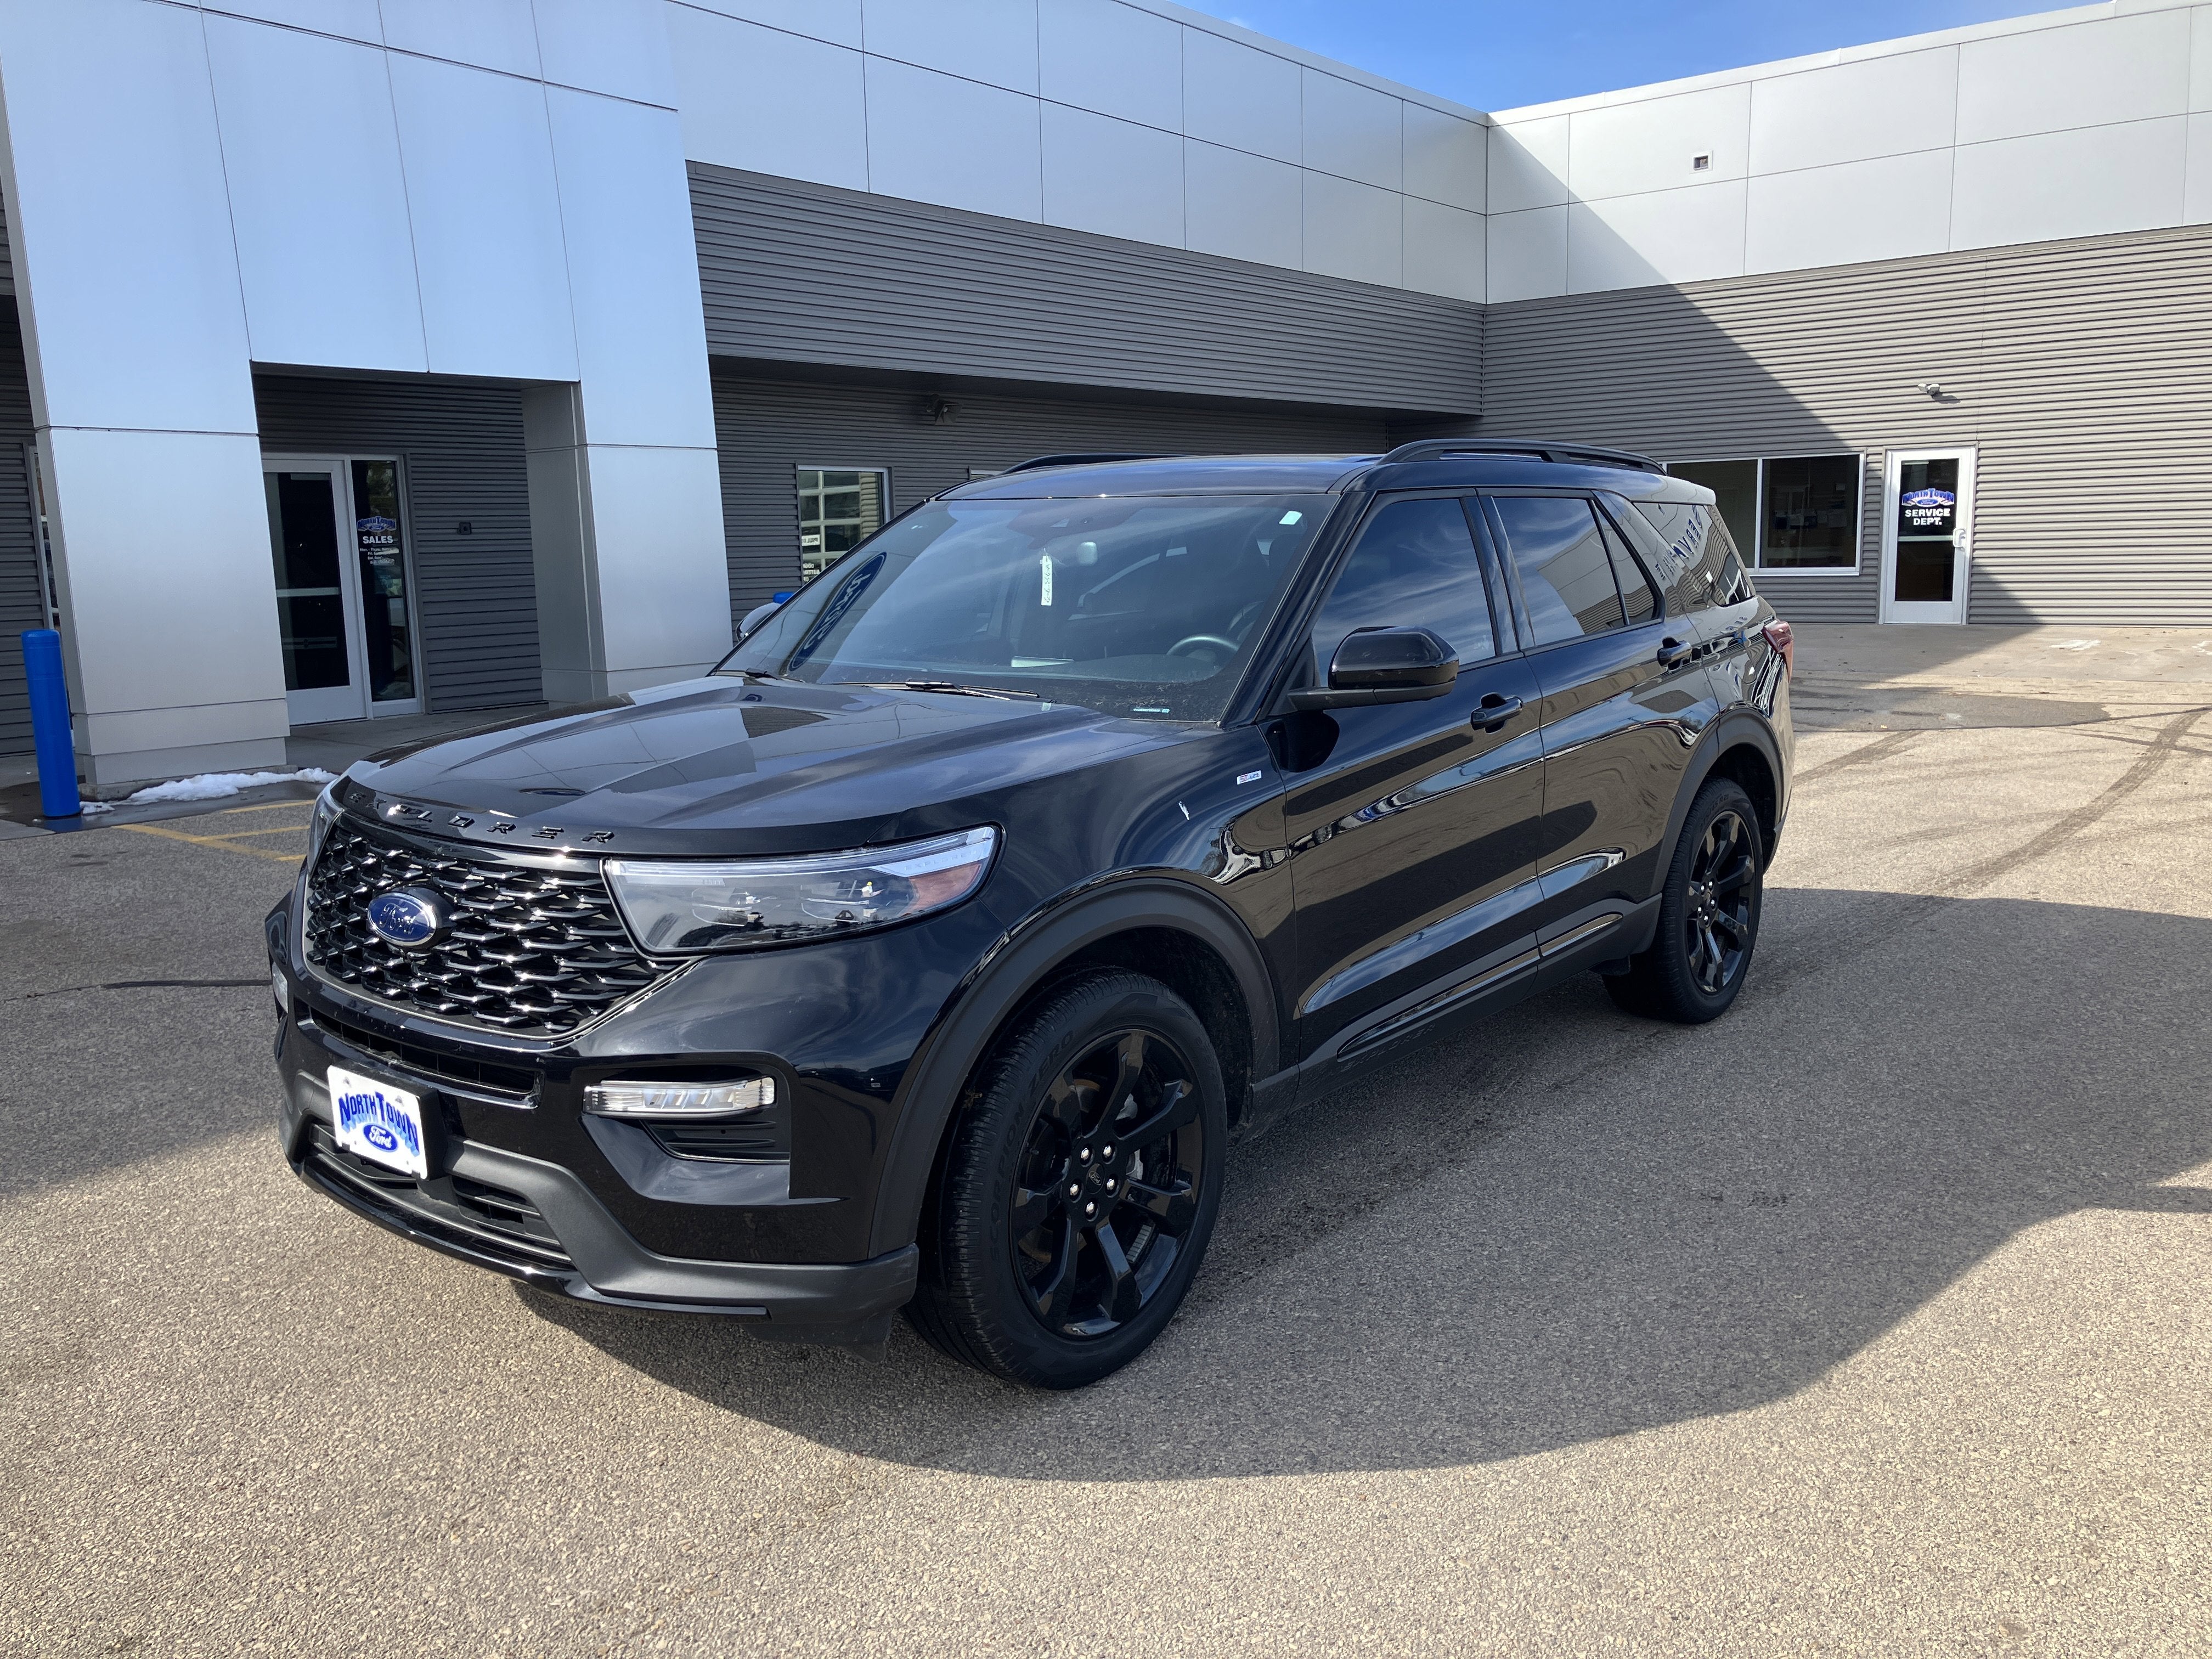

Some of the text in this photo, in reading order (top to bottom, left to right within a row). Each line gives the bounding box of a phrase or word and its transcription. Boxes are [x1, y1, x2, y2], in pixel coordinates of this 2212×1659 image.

[1905, 508, 1950, 518] SERVICE
[1913, 517, 1942, 526] DEPT.
[363, 535, 393, 544] SALES
[904, 850, 977, 871] EXPLORER
[379, 902, 419, 935] Ford
[1028, 1030, 1074, 1097] ZERO
[369, 1126, 392, 1149] Ford
